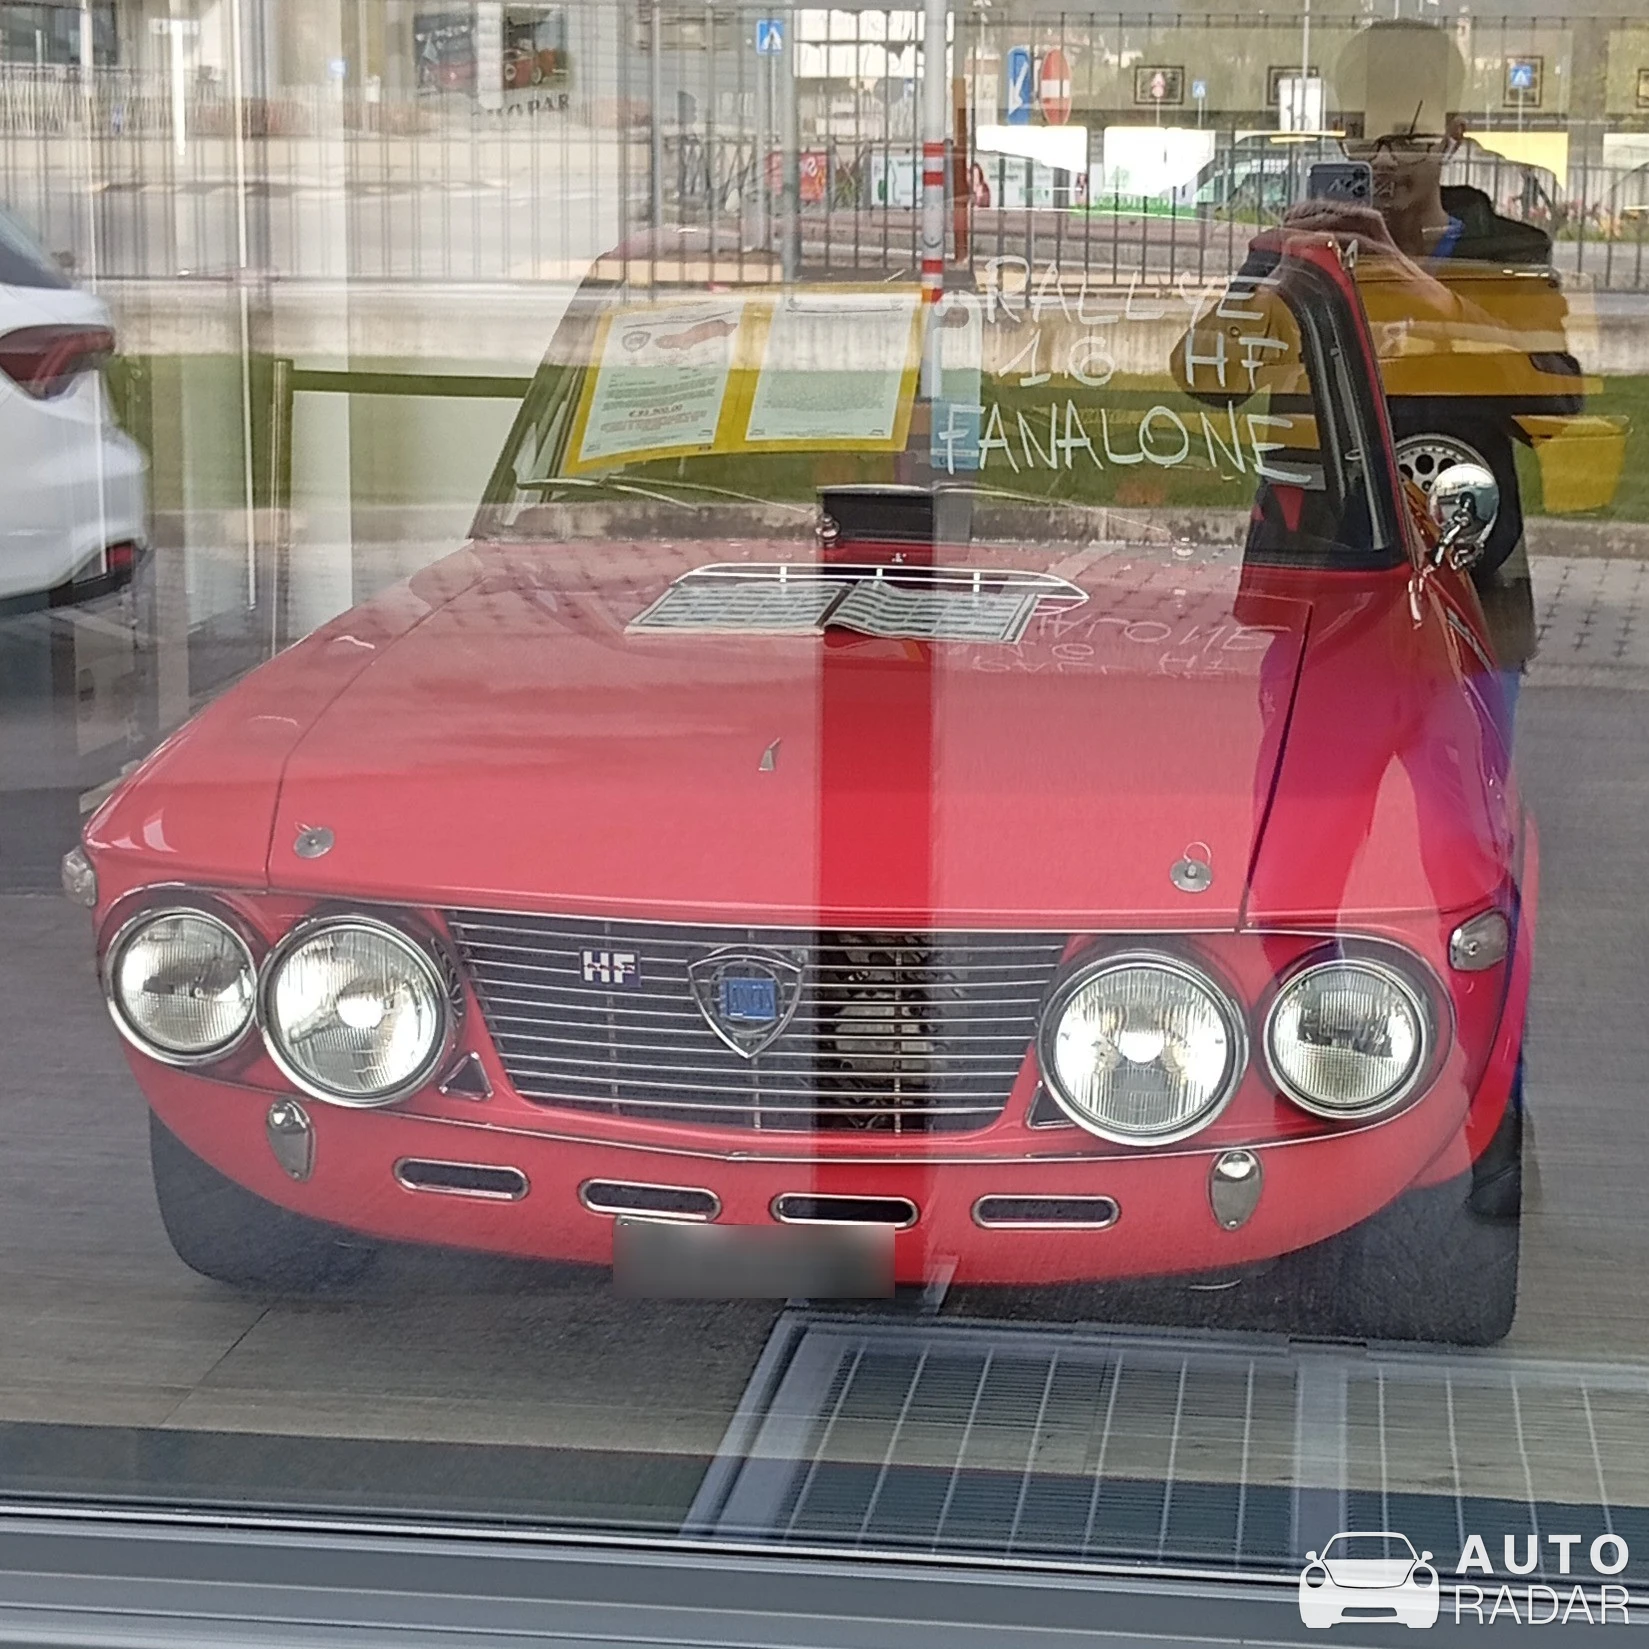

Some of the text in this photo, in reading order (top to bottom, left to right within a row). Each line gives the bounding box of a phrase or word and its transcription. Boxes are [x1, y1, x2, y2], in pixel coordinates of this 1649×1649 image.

[984, 255, 1281, 328] RALLYE
[1184, 330, 1290, 391] HF
[937, 399, 1312, 484] FANALONE
[583, 950, 635, 983] HF
